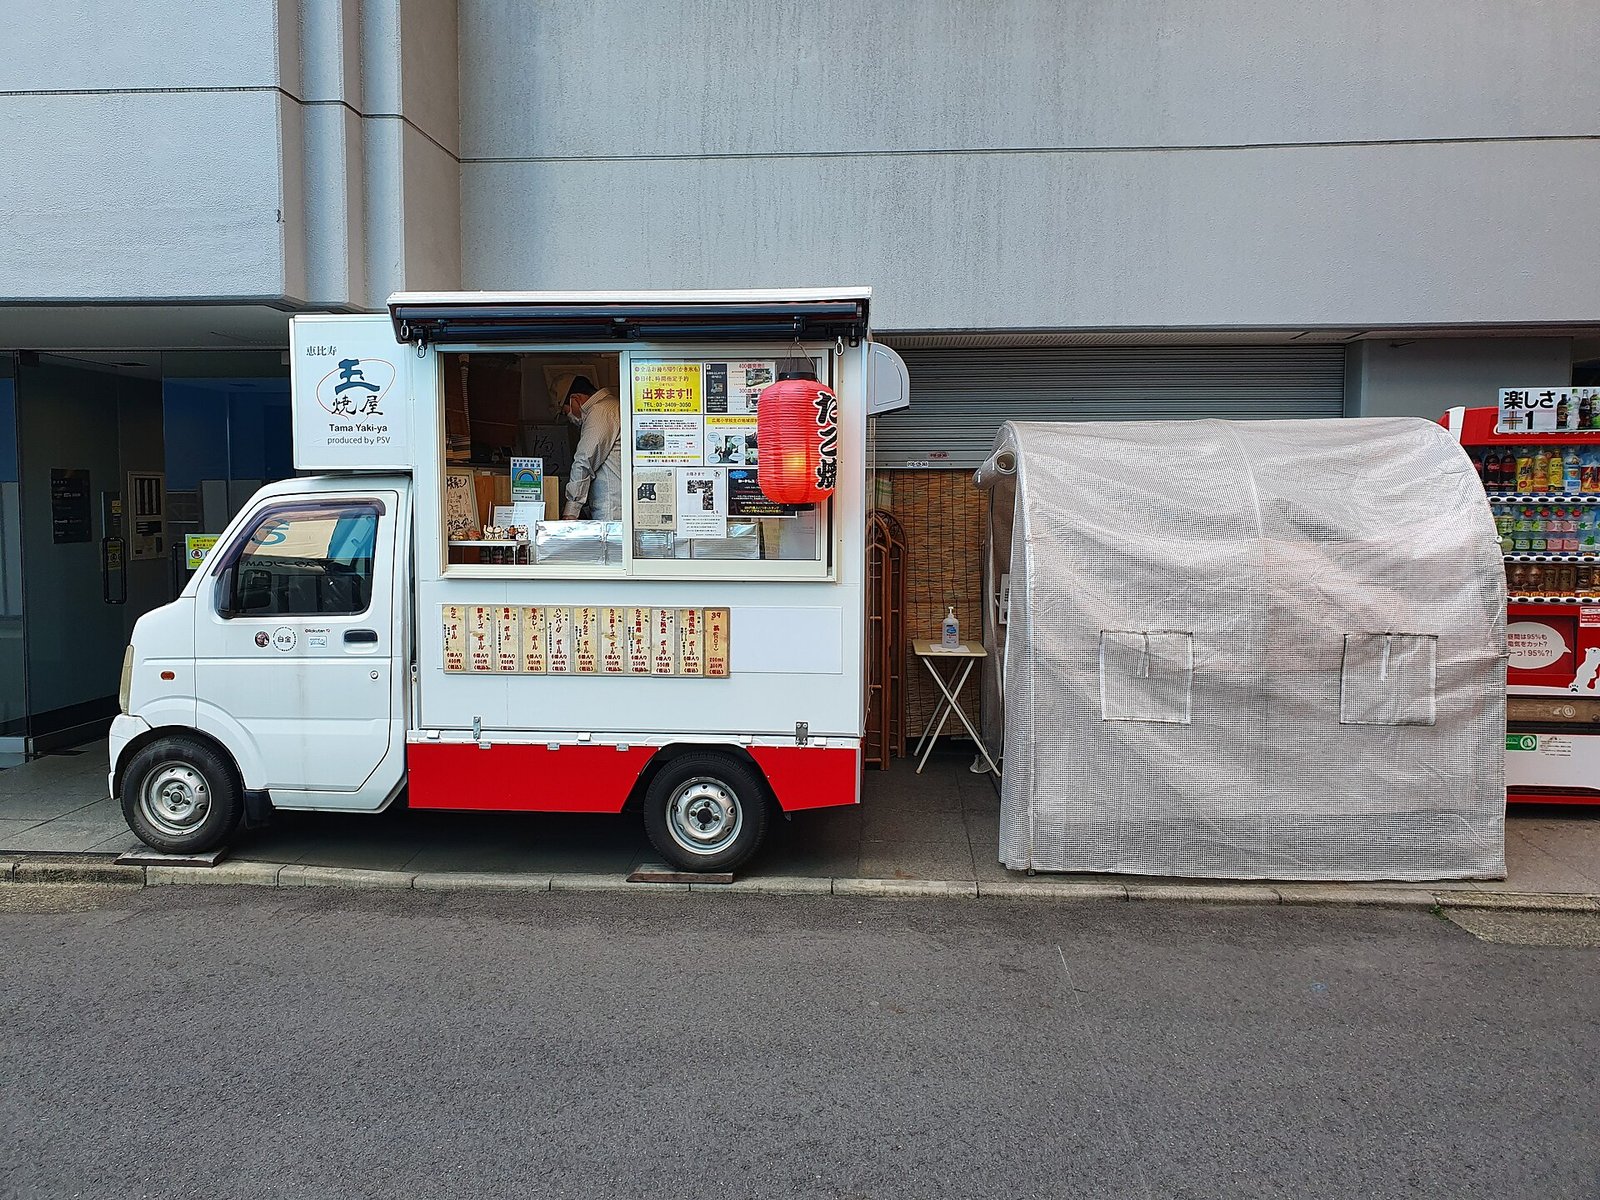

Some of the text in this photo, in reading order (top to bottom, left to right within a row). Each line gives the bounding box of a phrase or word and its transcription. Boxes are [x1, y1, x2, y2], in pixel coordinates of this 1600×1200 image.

[306, 345, 337, 357] 恵比寿
[642, 388, 692, 400] 出来ます!!
[1503, 390, 1556, 410] 楽しさ
[332, 395, 384, 416] 焼屋
[329, 424, 388, 434] Tama Yaki-ya
[327, 437, 363, 445] produced
[364, 436, 375, 446] by
[277, 635, 292, 643] 白金
[1507, 640, 1548, 648] 電気をカット?
[1527, 649, 1553, 657] 95%?!
